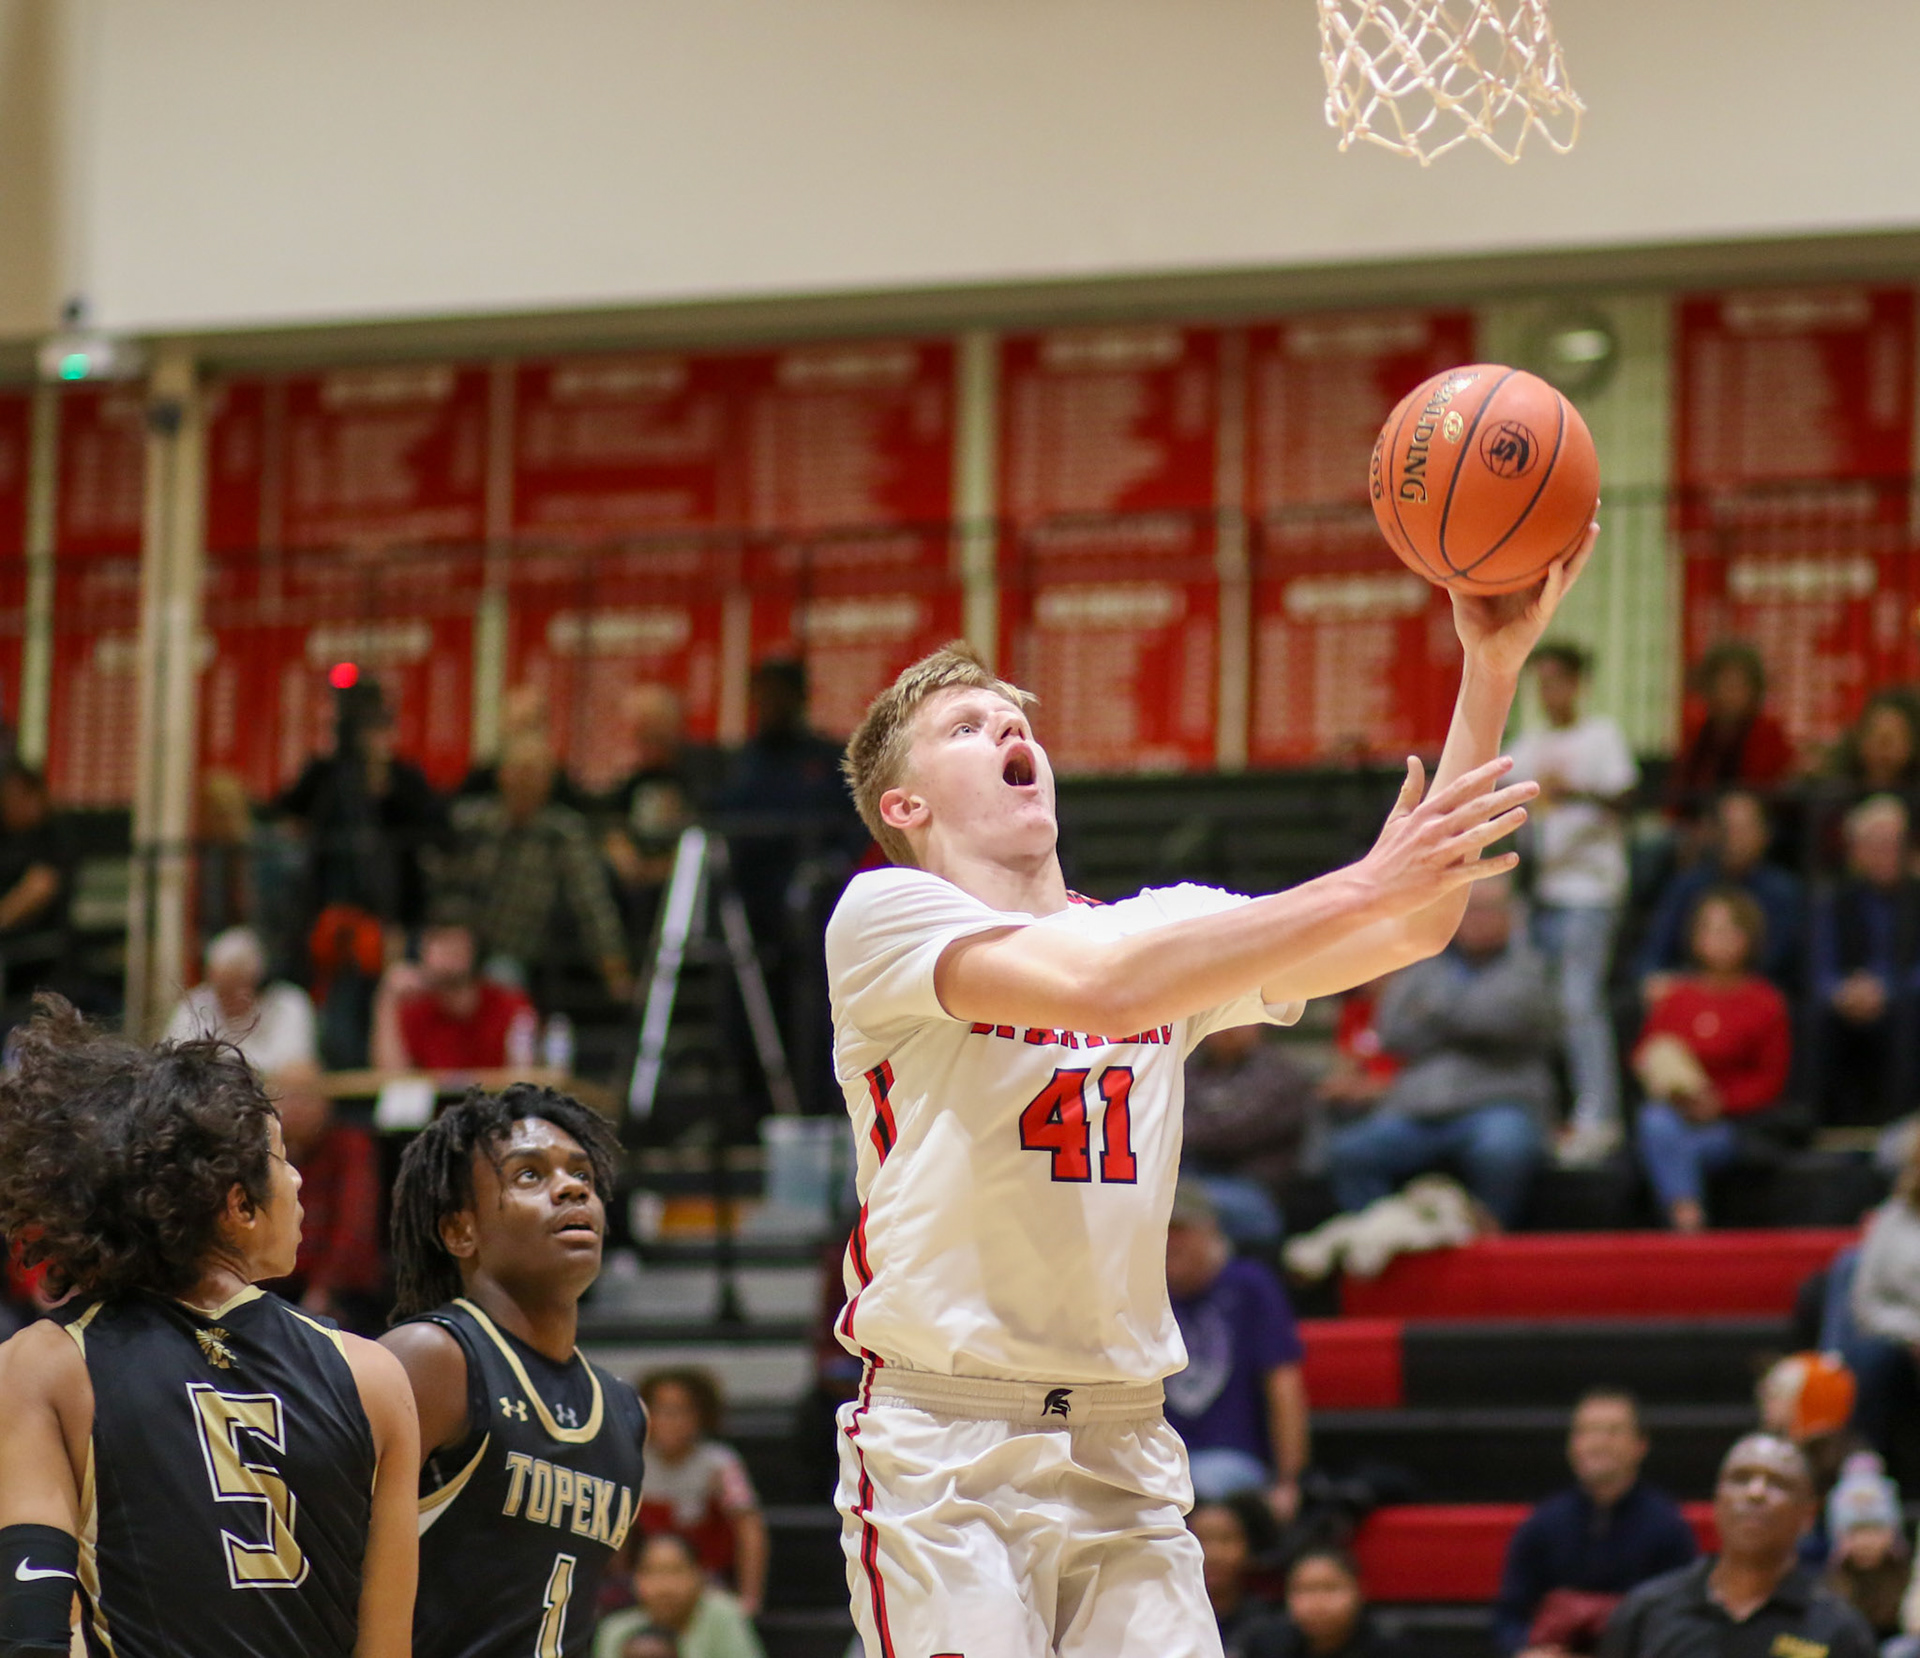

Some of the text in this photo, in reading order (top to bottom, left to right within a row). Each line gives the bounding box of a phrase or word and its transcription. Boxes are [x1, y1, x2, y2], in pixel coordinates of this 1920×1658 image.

[1399, 373, 1481, 503] PALDING
[1018, 1065, 1138, 1185] 41
[185, 1381, 311, 1590] 5
[502, 1450, 632, 1551] TOPEKA
[534, 1552, 577, 1658] 1
